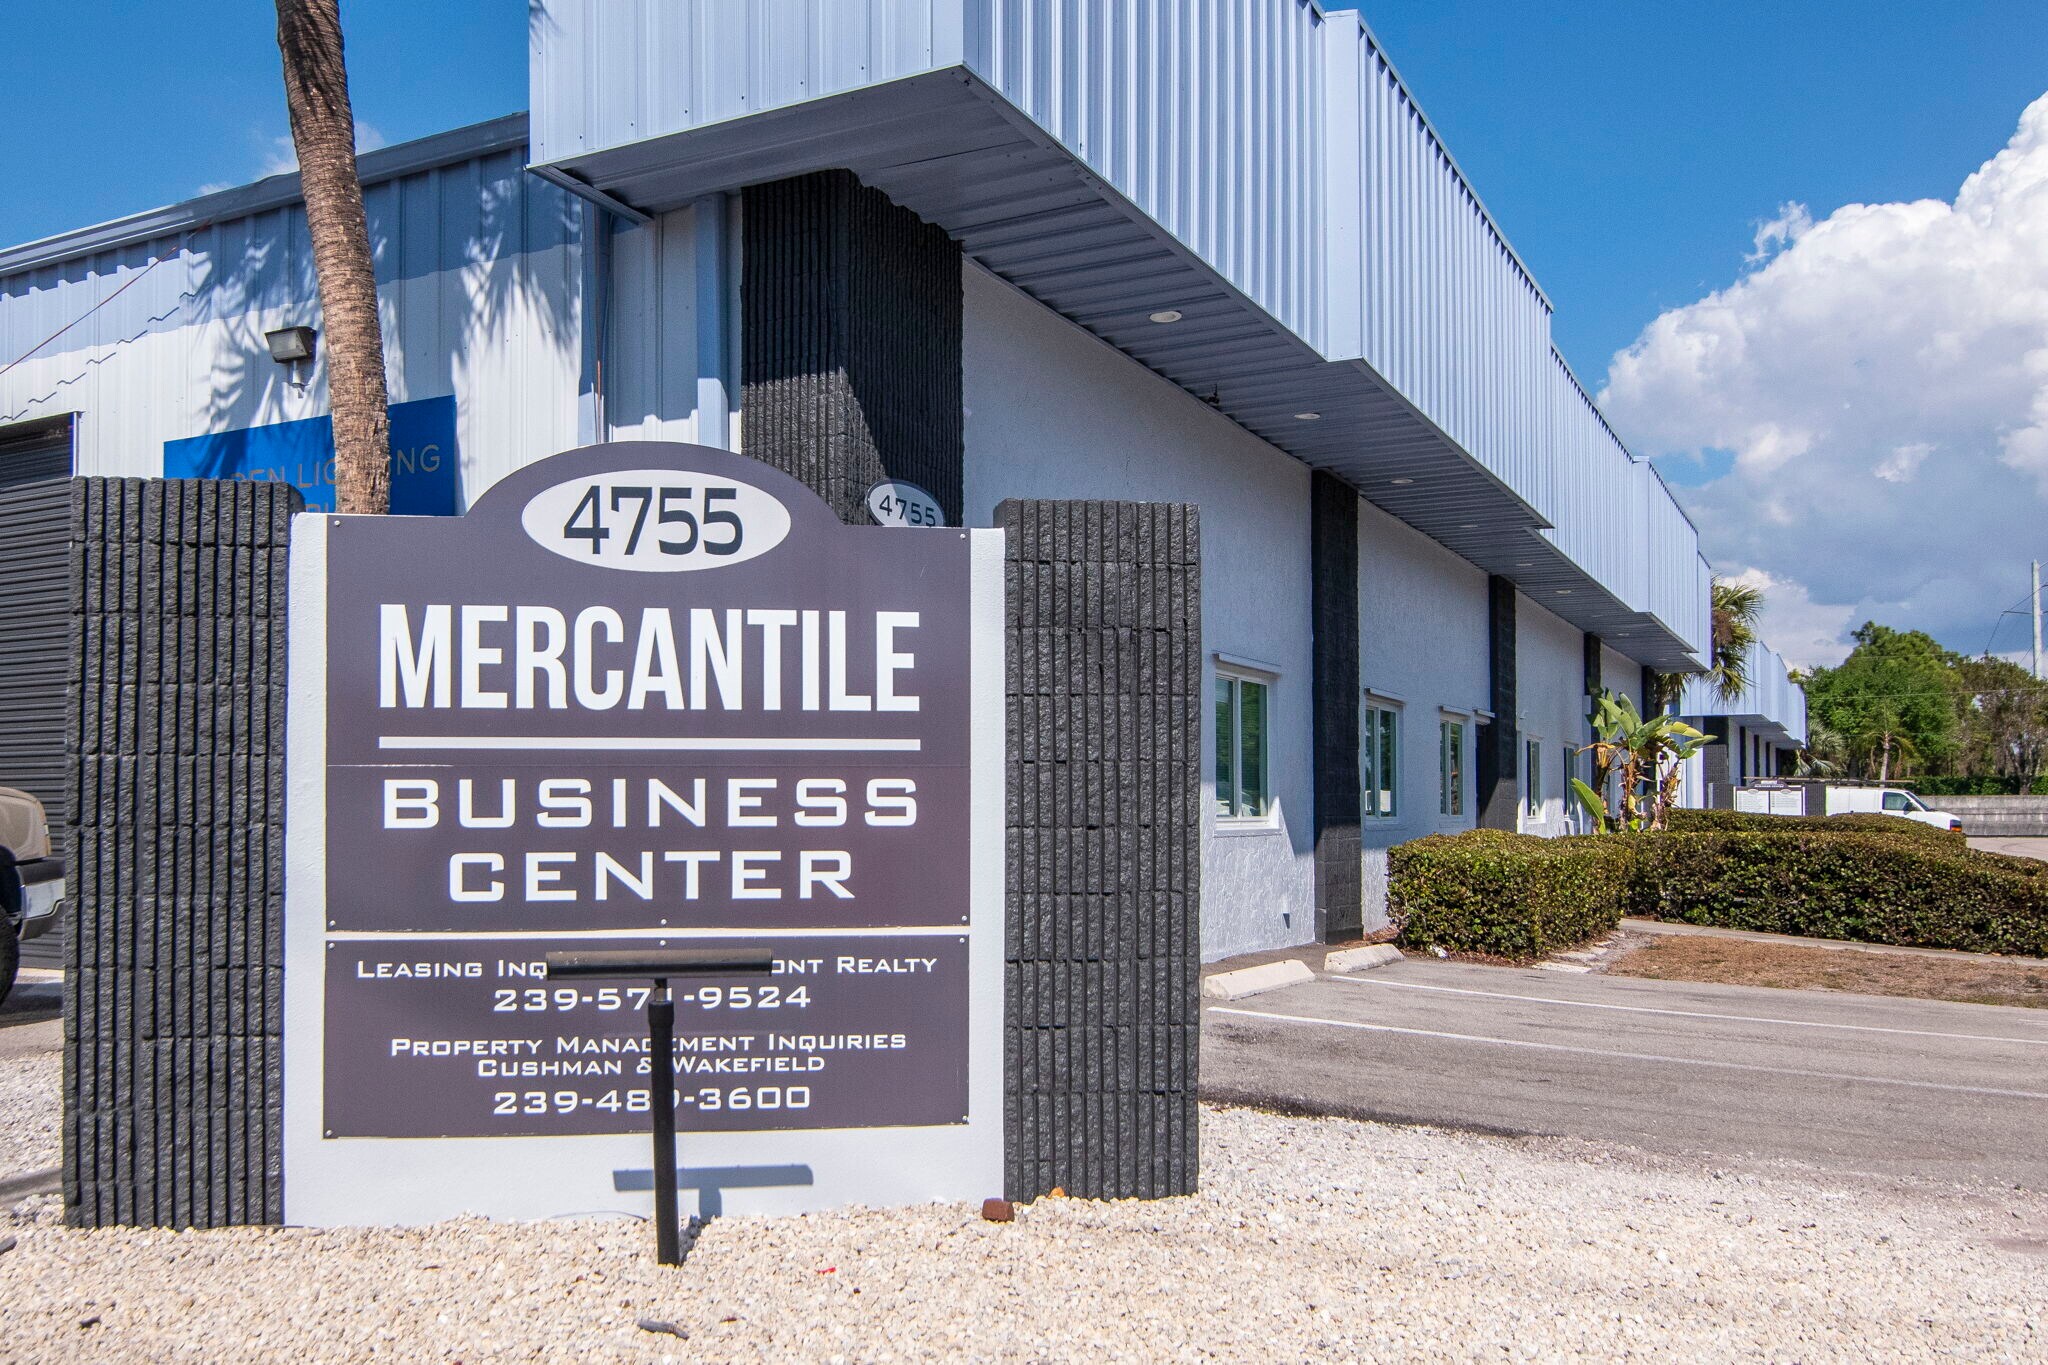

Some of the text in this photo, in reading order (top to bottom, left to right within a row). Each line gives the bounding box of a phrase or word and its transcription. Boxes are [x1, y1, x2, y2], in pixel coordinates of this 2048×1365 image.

[563, 485, 743, 556] 4755
[879, 494, 936, 526] 4755
[379, 604, 920, 712] MERCANTILE
[383, 778, 917, 829] BUSINESS
[449, 850, 855, 902] CENTER
[357, 960, 483, 978] LEASING
[837, 956, 937, 973] REALTY
[391, 1033, 906, 1056] PROPERTY MANAGMENT INQUIRIES
[478, 1056, 825, 1077] CUSHMAN & WAKEFIELD
[493, 1086, 811, 1115] 239-48-3600
